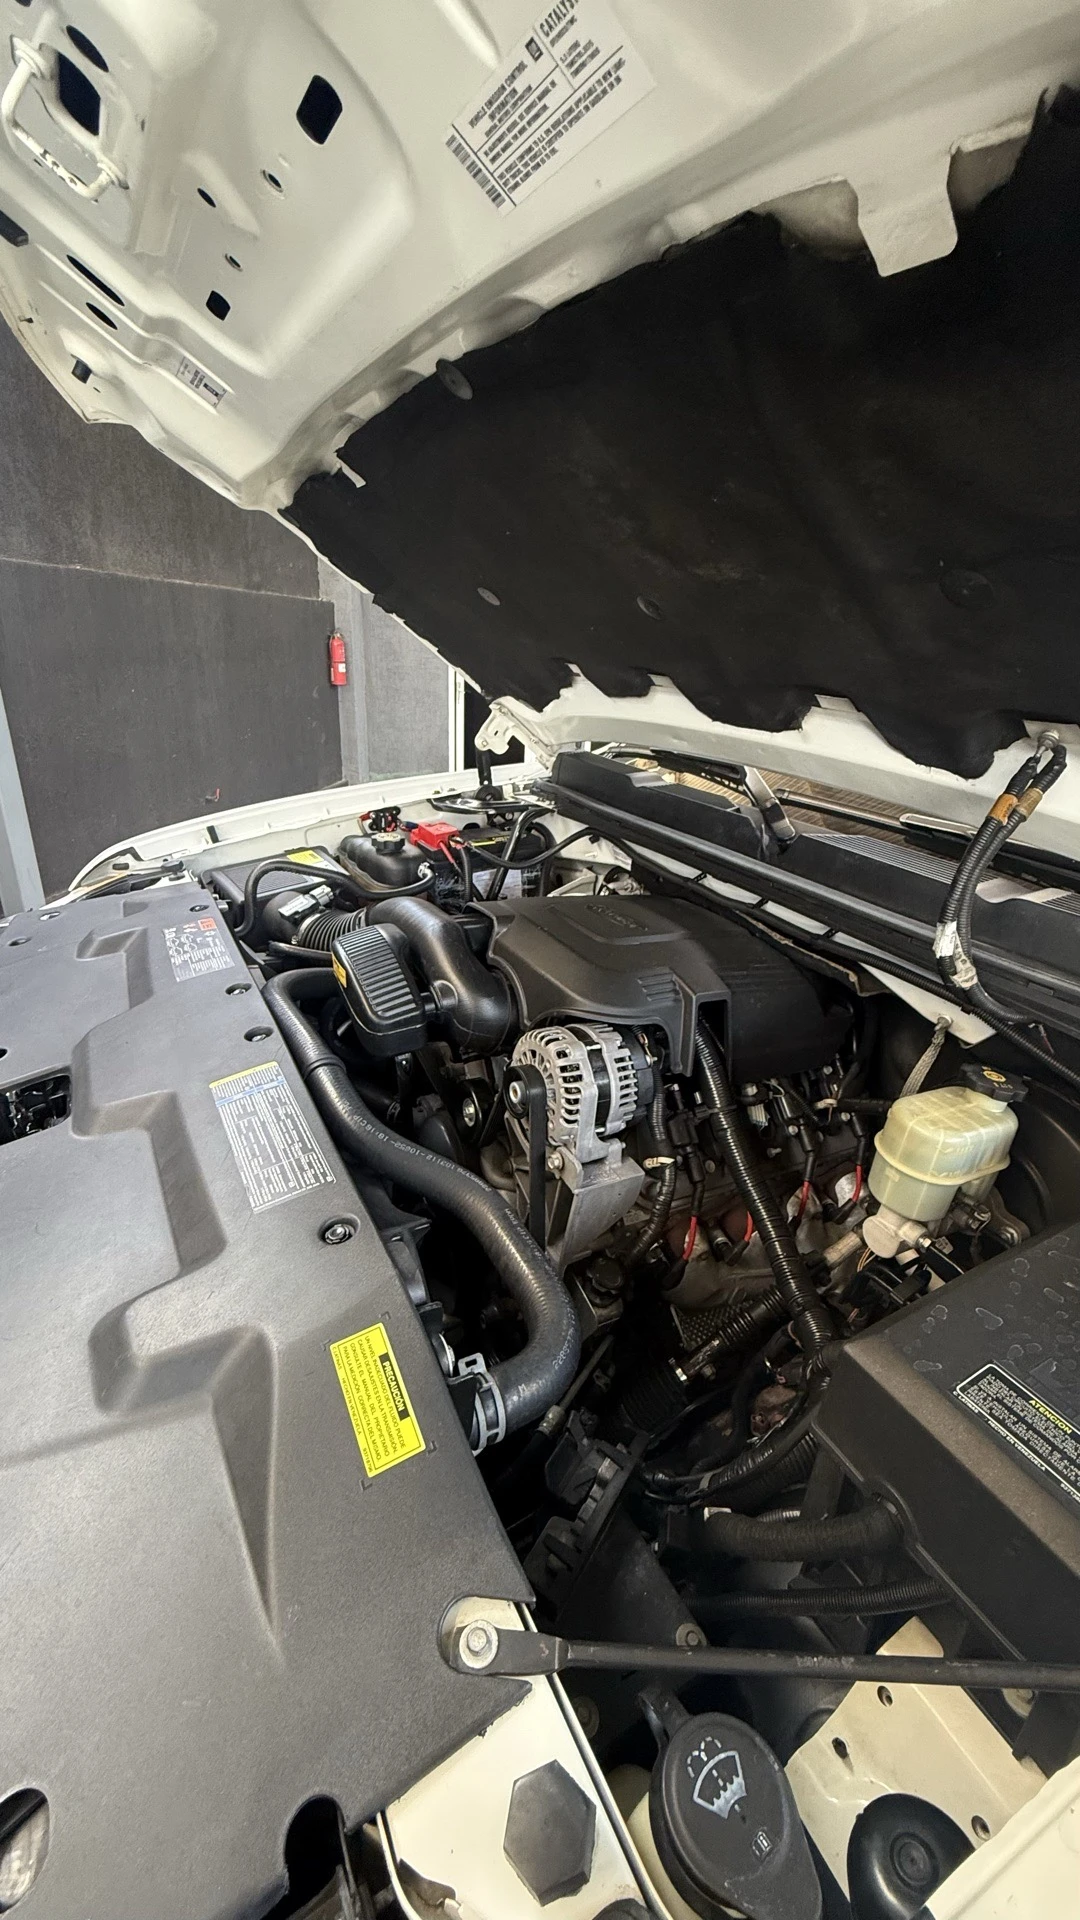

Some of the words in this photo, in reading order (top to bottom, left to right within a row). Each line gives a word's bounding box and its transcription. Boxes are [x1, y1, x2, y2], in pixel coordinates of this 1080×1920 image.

[357, 1338, 368, 1360] CAUSAR
[364, 1335, 371, 1344] UN
[366, 1343, 375, 1358] NIVEL
[363, 1359, 379, 1395] DESAJUSTES
[371, 1358, 387, 1394] INADECUADO
[382, 1360, 405, 1411] PRECAUCIÓN
[342, 1345, 350, 1359] PARA
[346, 1359, 352, 1367] LA
[357, 1394, 371, 1427] CORRECTA
[367, 1426, 375, 1439] DEL
[349, 1341, 362, 1369] CONSULTE
[358, 1369, 364, 1377] EL
[361, 1378, 372, 1402] MANUAL
[373, 1416, 390, 1457] PROPIETARIO
[375, 1394, 382, 1404] EN
[383, 1393, 391, 1405] DEL
[378, 1403, 384, 1412] LA
[387, 1405, 398, 1428] FLUIDO
[1028, 1398, 1073, 1434] ATENCION
[394, 1427, 405, 1449] PUEDE
[958, 1395, 979, 1413] LATINAS
[986, 1420, 1006, 1437] HECHO
[1005, 1435, 1015, 1444] EN
[1013, 1443, 1046, 1471] VENEZUELA
